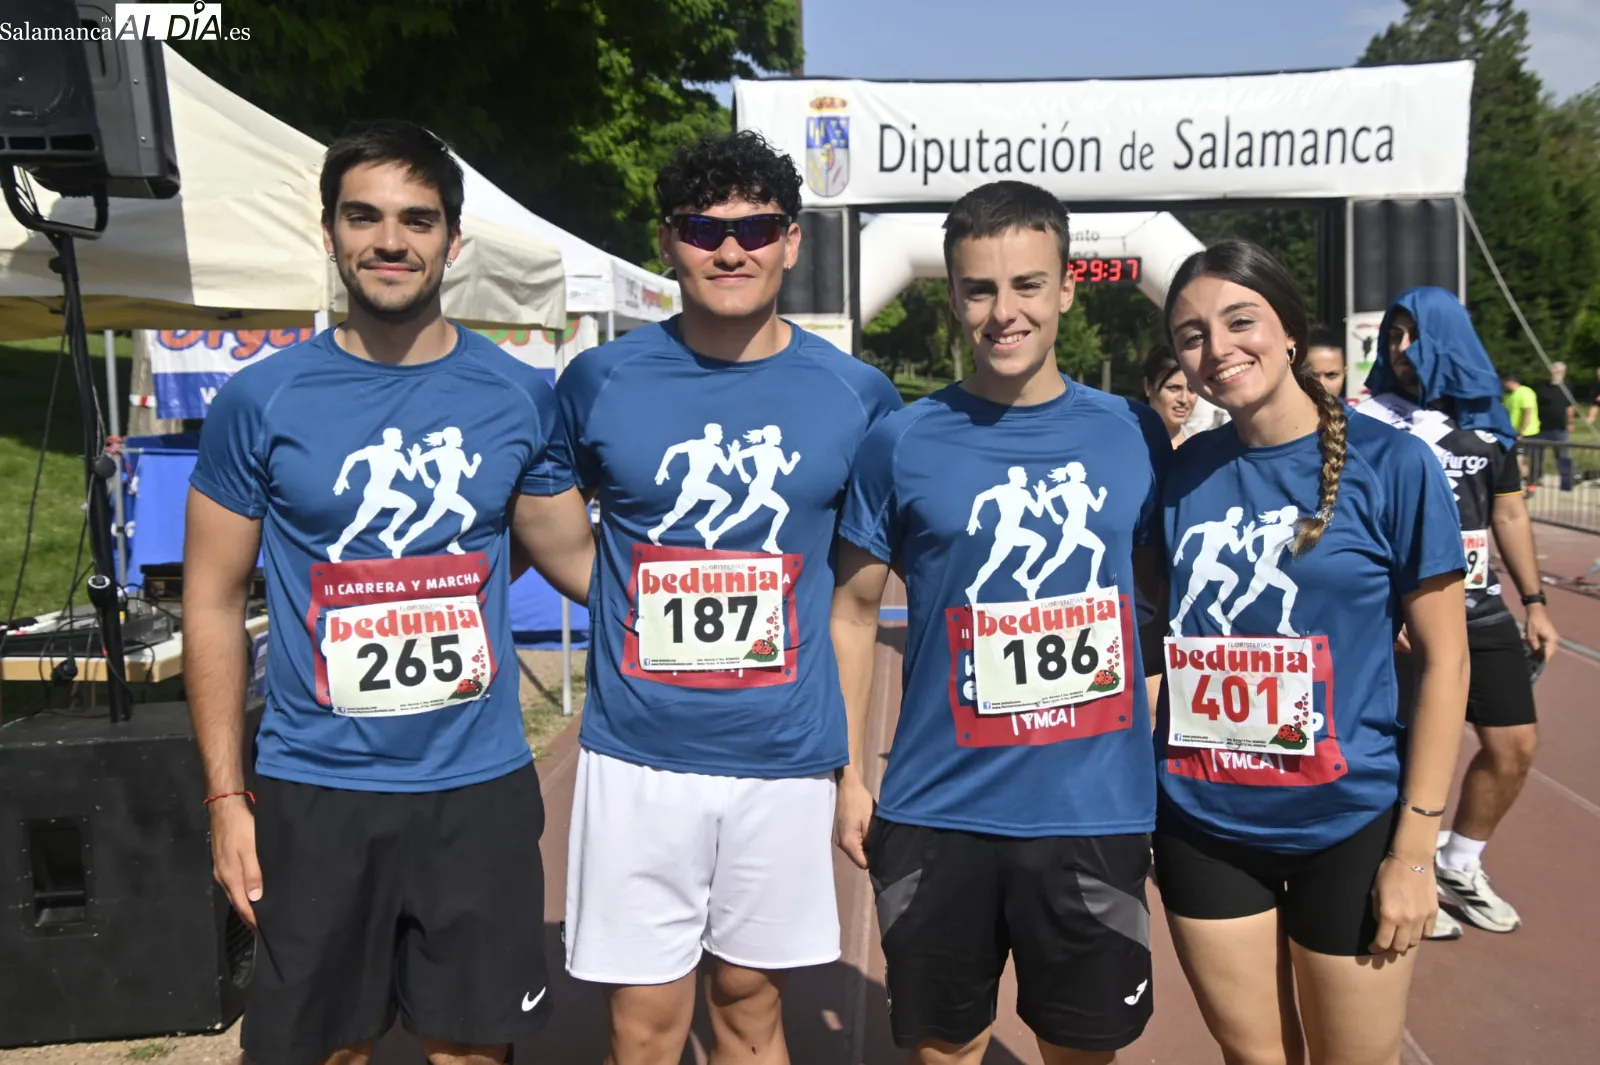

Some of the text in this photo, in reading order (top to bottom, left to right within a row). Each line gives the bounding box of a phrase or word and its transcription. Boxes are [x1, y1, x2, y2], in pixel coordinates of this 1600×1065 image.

[879, 115, 1394, 186] Diputación de Salamanca
[338, 581, 406, 595] CARRERA
[411, 580, 421, 591] Y
[426, 572, 480, 590] MARCHA
[641, 566, 779, 595] bedunia
[330, 604, 479, 643] bedunia
[663, 595, 758, 644] 187
[977, 597, 1116, 637] bedunia
[356, 633, 463, 692] 265
[1003, 627, 1099, 685] 186
[1168, 643, 1308, 673] bedunia
[1020, 708, 1068, 730] YMCA
[1191, 674, 1279, 725] 401
[1219, 752, 1275, 770] YMCA
